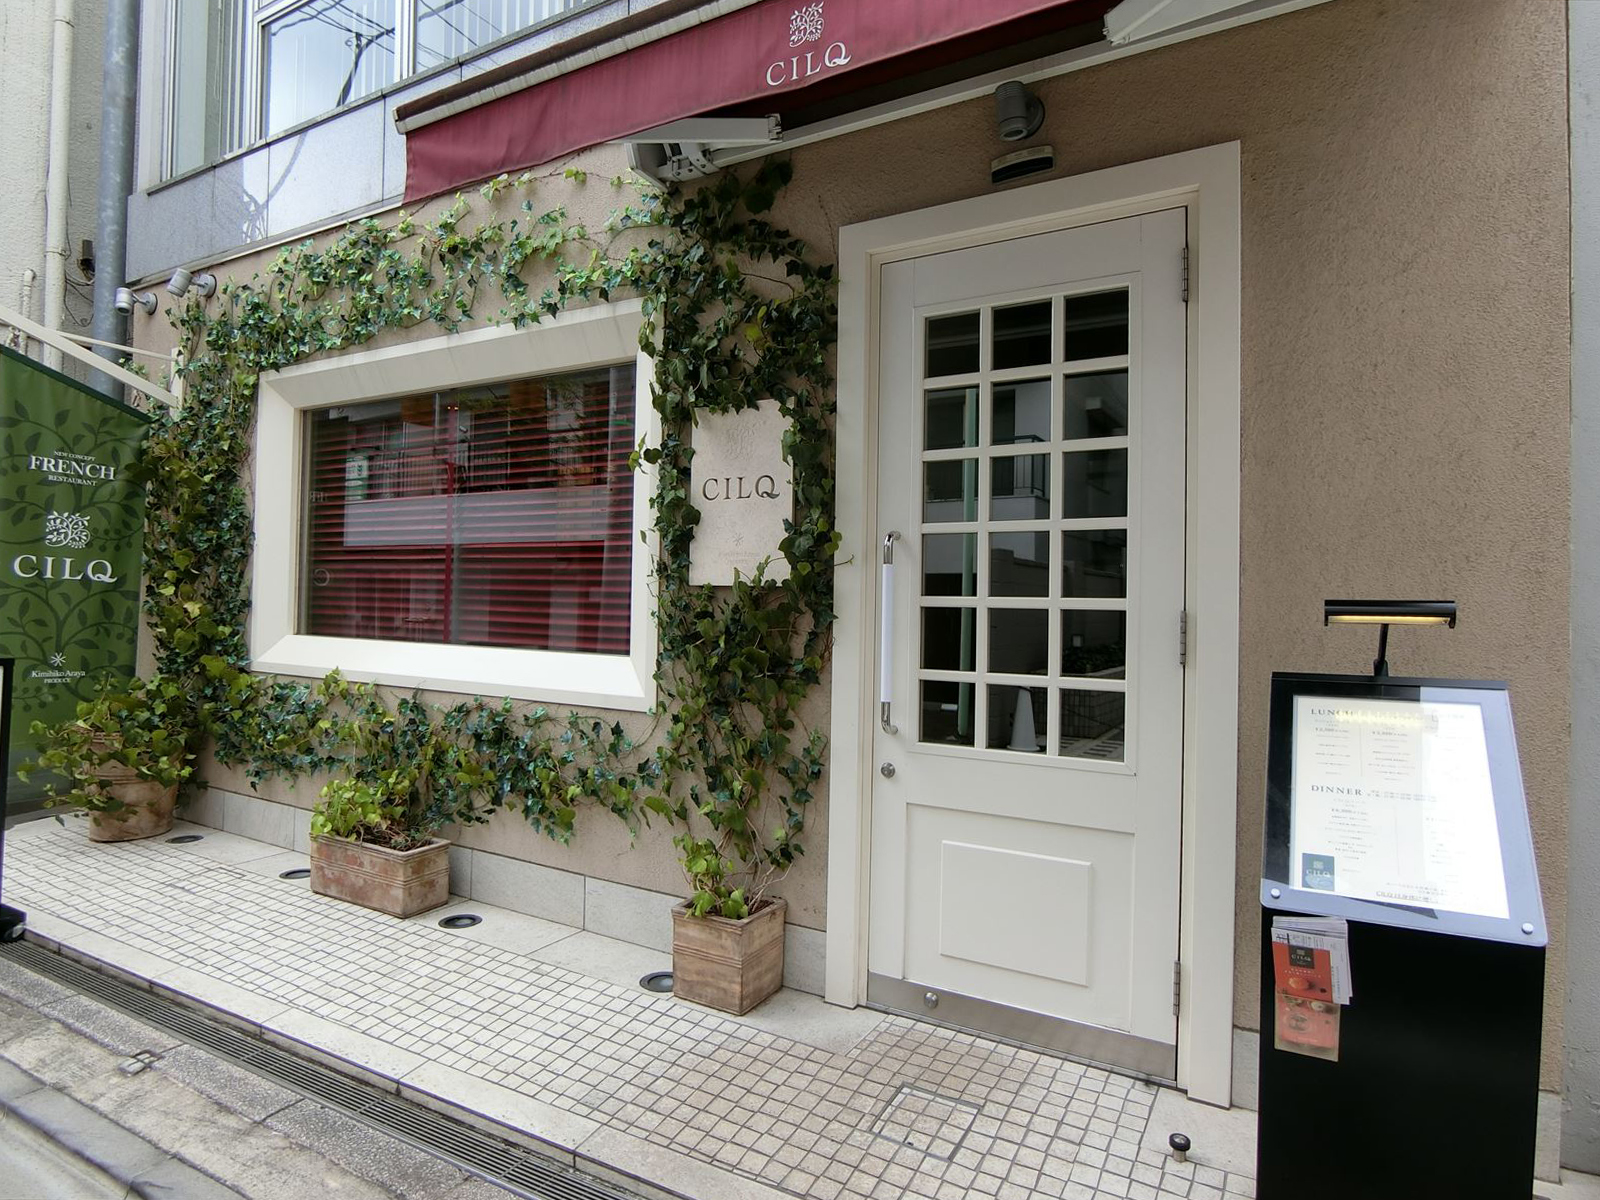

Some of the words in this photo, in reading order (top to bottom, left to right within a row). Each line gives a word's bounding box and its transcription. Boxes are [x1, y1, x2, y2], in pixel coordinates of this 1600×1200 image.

[766, 42, 852, 86] CILQ
[30, 455, 116, 480] FRENCH
[48, 475, 97, 486] RESTAURANT
[702, 475, 780, 501] CILQ
[14, 555, 118, 583] CILQ
[65, 670, 86, 678] Araya
[1311, 785, 1363, 796] DINNER
